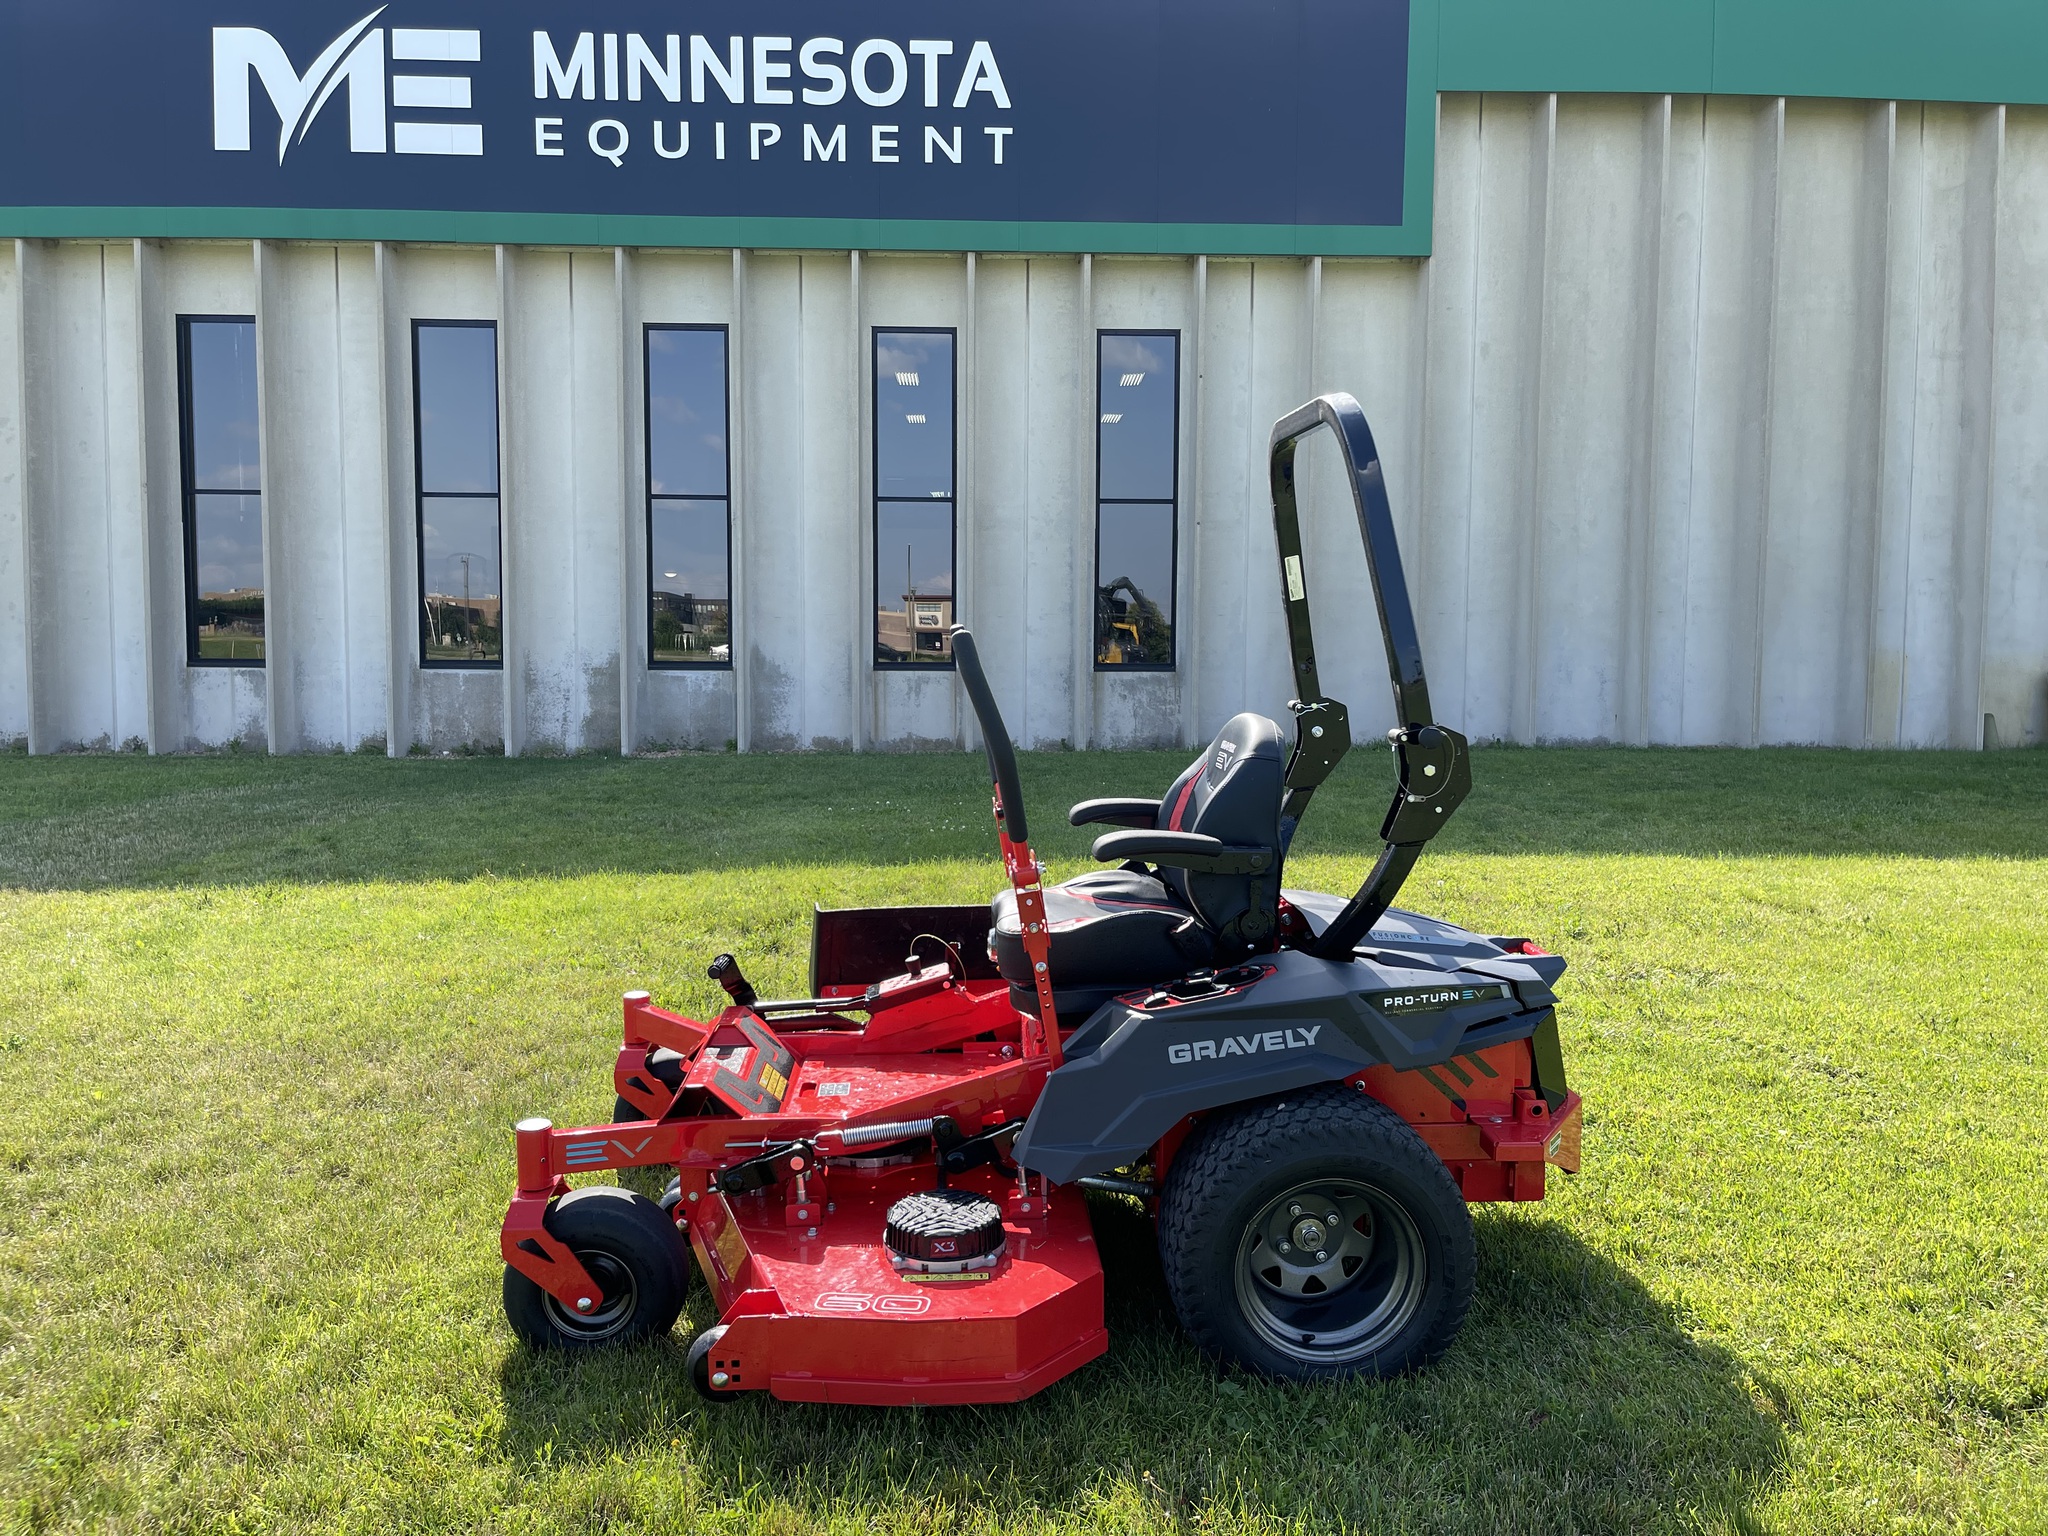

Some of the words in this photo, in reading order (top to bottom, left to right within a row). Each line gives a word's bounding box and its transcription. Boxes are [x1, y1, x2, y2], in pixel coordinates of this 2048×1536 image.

[212, 4, 483, 166] ME
[533, 30, 1012, 109] MINNESOTA
[535, 117, 1014, 168] EQUIPMENT
[1383, 991, 1460, 1008] PRO-TURN
[1462, 989, 1485, 1000] EV
[1167, 1025, 1322, 1064] GRAVELY
[565, 1136, 654, 1165] EV
[934, 1241, 955, 1253] X3
[814, 1292, 931, 1315] 60
